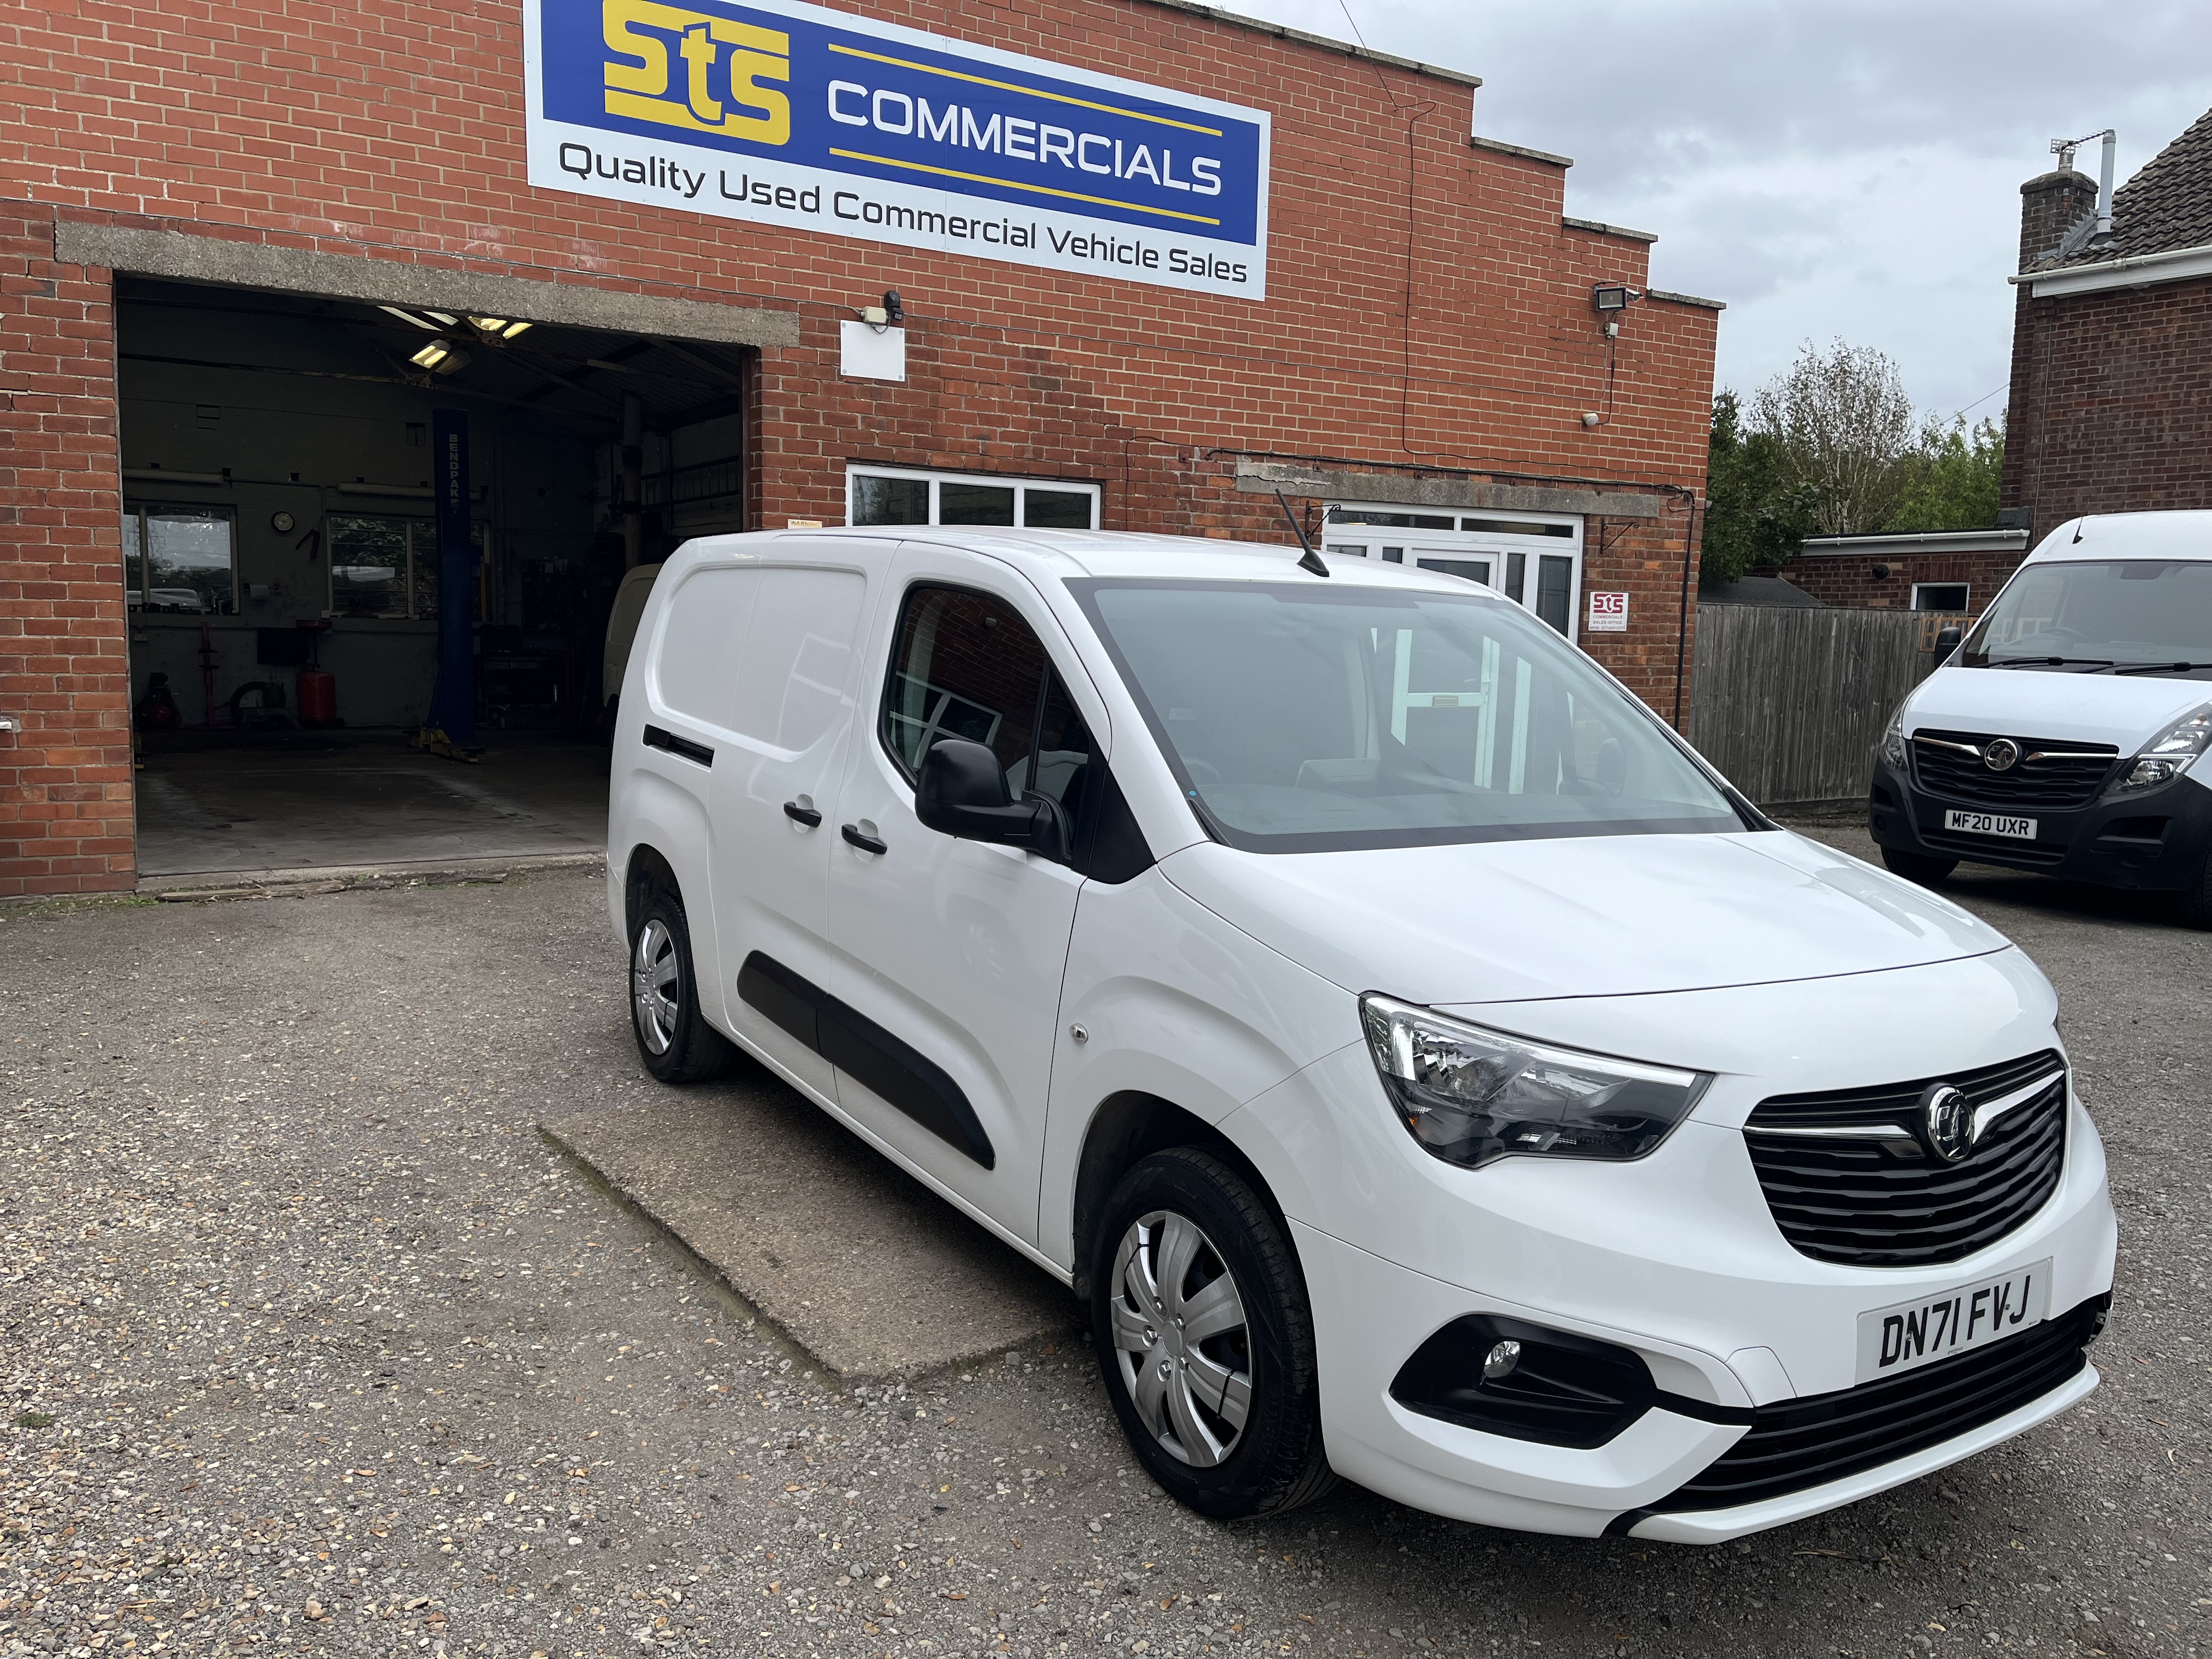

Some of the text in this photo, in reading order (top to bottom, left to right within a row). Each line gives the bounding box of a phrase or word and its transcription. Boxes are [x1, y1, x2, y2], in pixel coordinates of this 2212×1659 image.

[828, 80, 1221, 195] COMMERCIALS
[560, 143, 1247, 283] Quality Used Commercial Vehicle Sales
[449, 434, 459, 497] BENDPAK
[1952, 812, 2029, 835] MF20 UXR
[1879, 1274, 2031, 1368] DN71 FVJ
